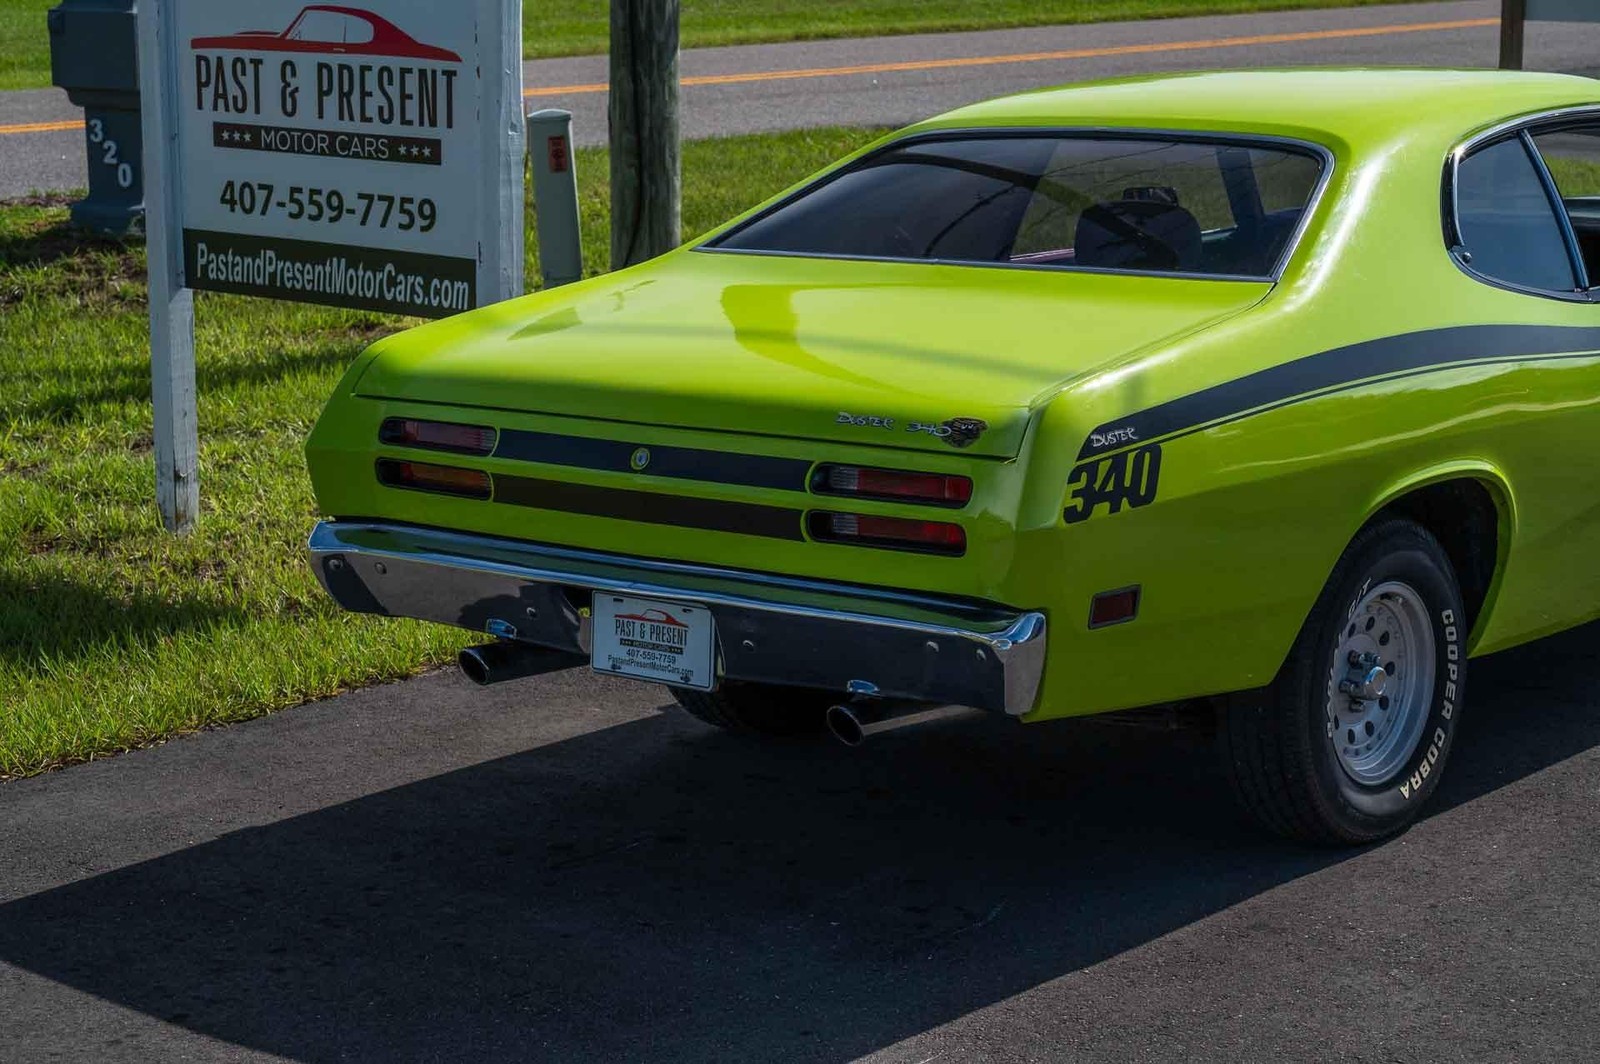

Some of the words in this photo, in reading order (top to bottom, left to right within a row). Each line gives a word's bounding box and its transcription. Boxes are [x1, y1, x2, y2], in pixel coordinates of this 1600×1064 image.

[195, 54, 264, 115] PAST
[280, 59, 299, 117] &
[317, 61, 458, 129] PRESENT
[260, 128, 330, 155] MOTOR
[335, 135, 389, 159] CARS
[219, 179, 437, 233] 407-559-7759
[196, 243, 469, 311] PastandPresentMotorCars.com
[1090, 427, 1139, 448] DUSTER
[1063, 443, 1162, 525] 340
[615, 619, 636, 638] PAST
[639, 623, 646, 639] &
[649, 625, 689, 646] PRESENT
[1441, 608, 1459, 721] COOPER
[1399, 727, 1446, 800] COBRA
